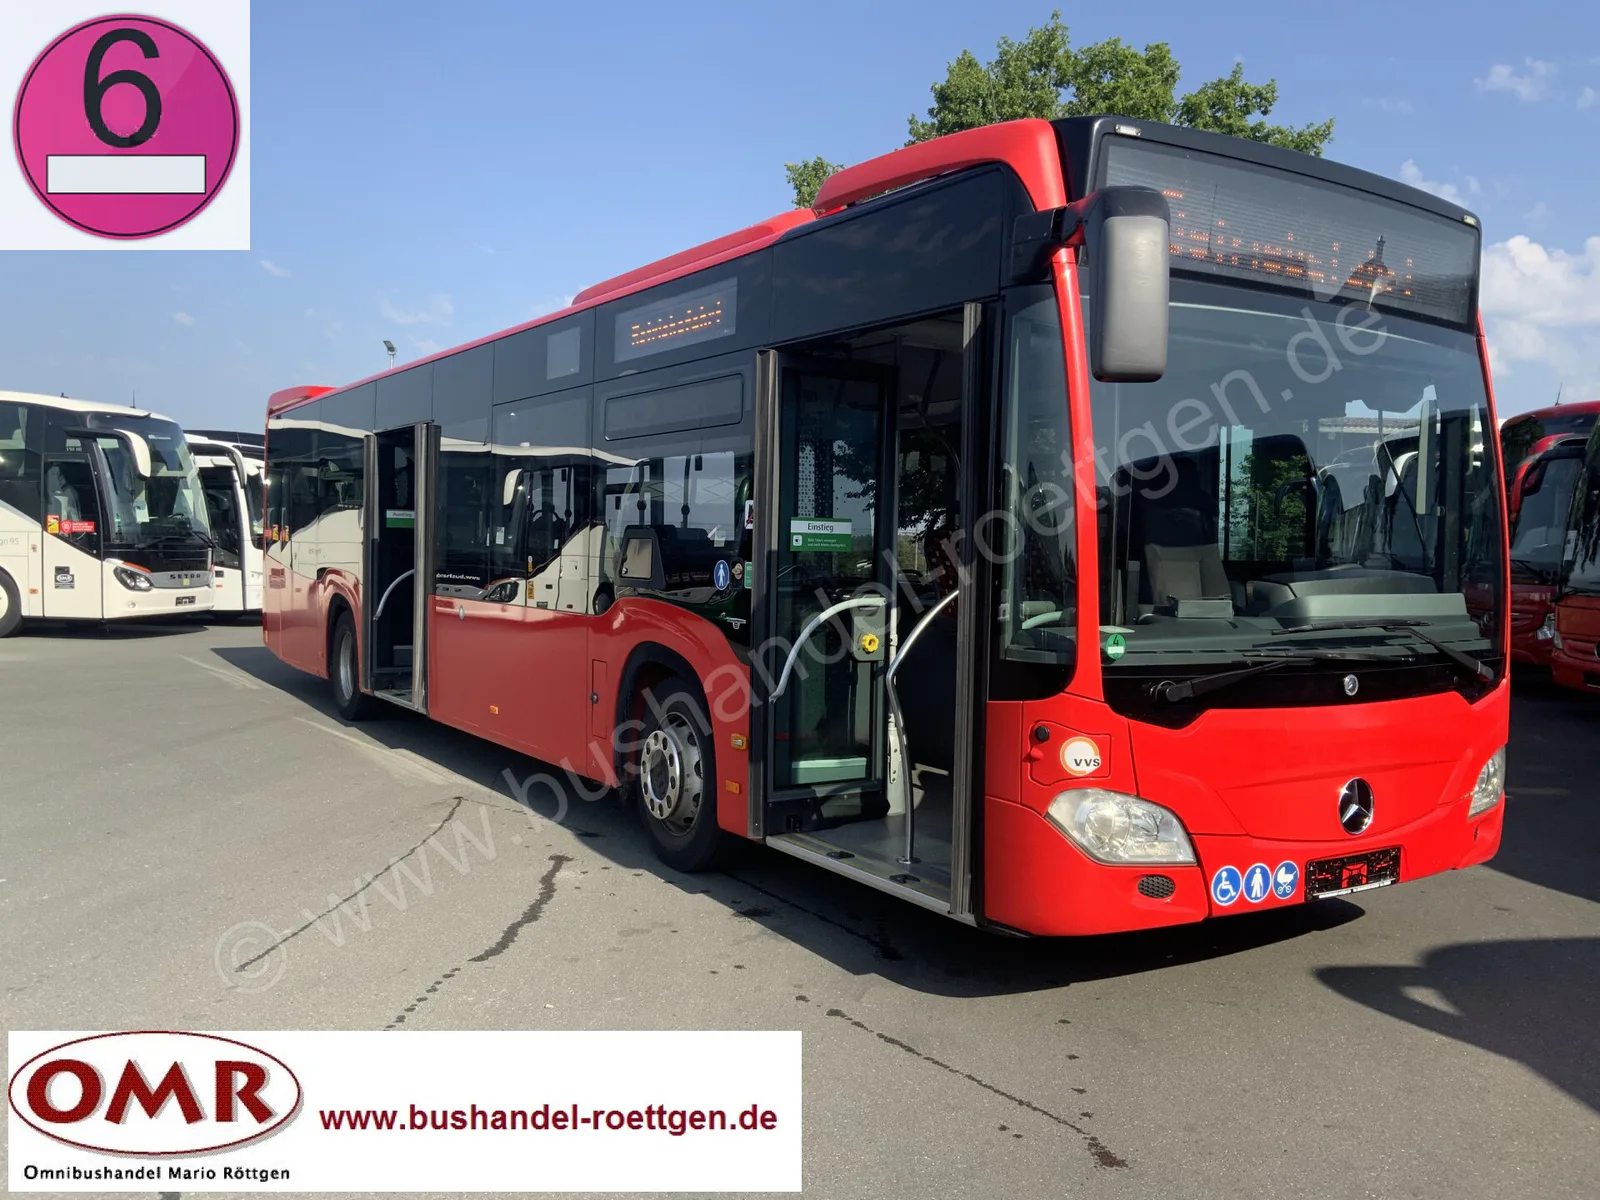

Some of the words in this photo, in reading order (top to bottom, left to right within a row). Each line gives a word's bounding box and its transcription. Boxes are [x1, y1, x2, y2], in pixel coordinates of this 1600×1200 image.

[808, 523, 834, 533] Einstieg
[9, 537, 20, 546] 95
[1113, 634, 1120, 647] 4
[1074, 758, 1100, 767] VVS
